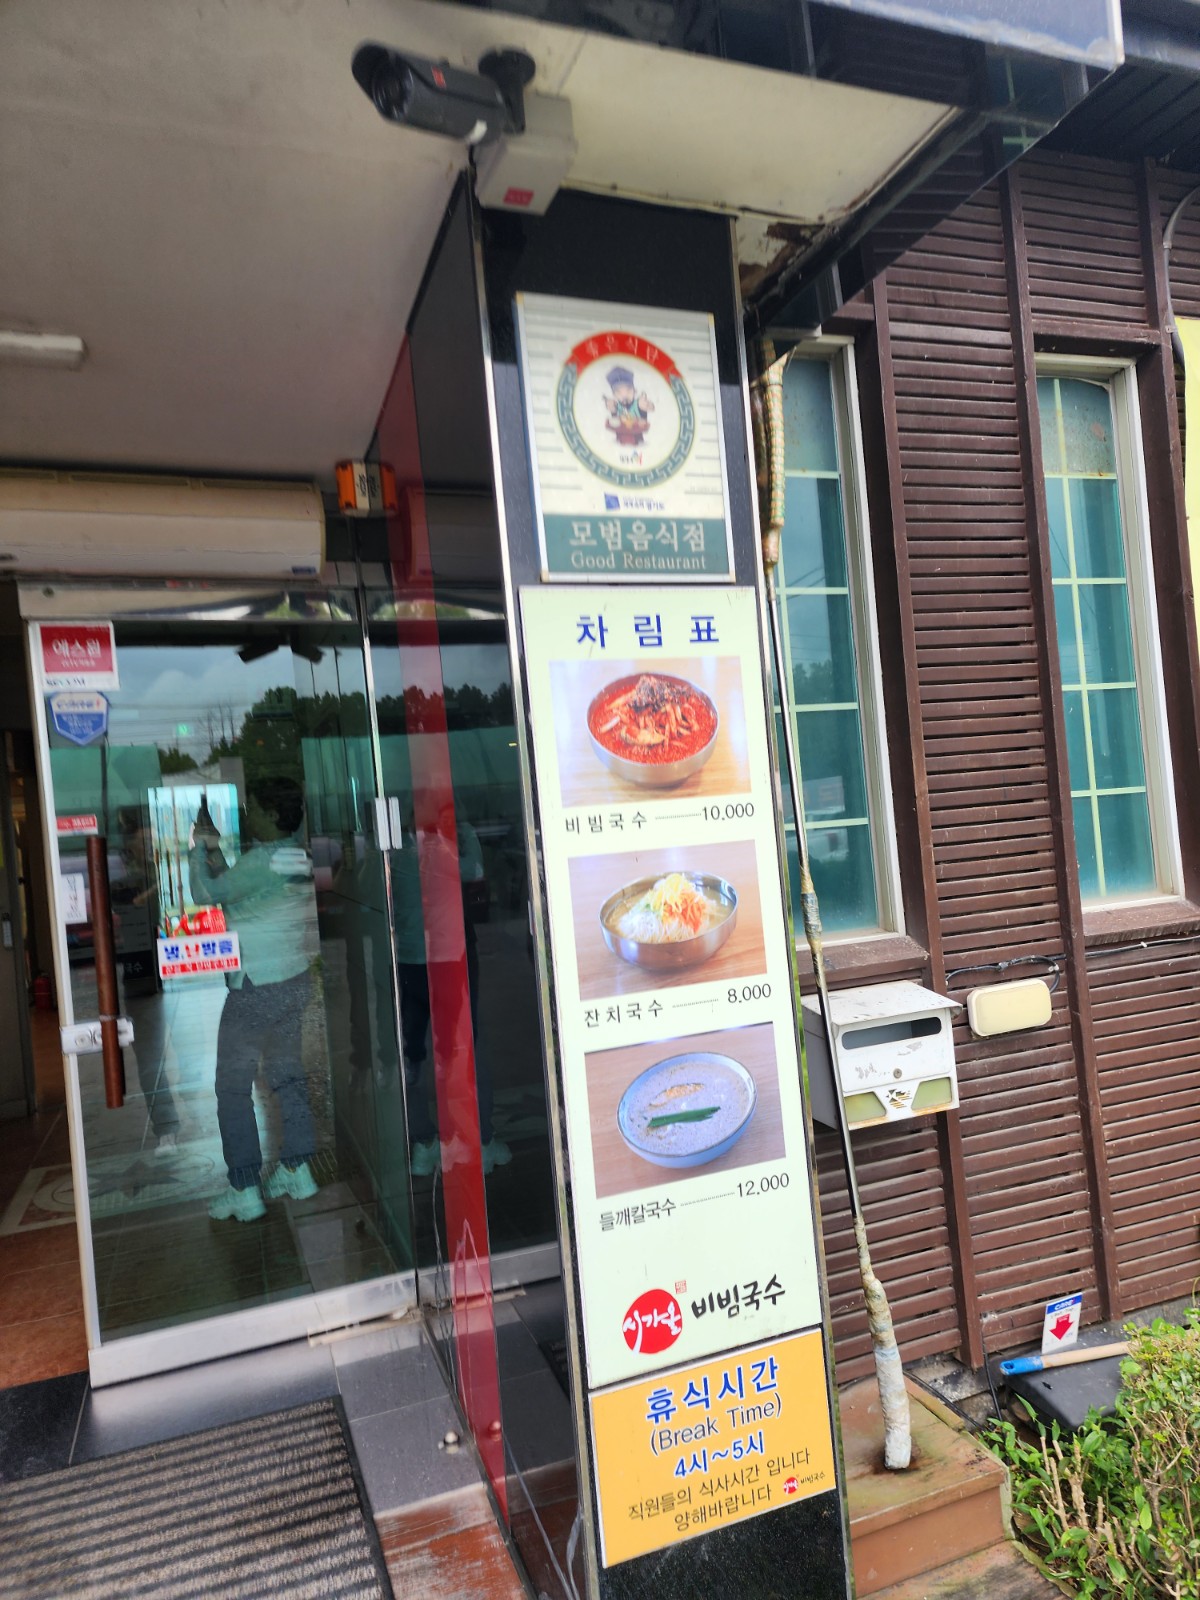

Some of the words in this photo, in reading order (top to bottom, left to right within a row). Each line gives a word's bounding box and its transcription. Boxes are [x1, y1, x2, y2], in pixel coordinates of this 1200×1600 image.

[569, 518, 705, 552] 모범음식점
[571, 551, 616, 569] Good
[623, 552, 706, 570] Restaurant
[52, 638, 101, 659] 에스원
[564, 811, 648, 835] 비빔국수
[583, 999, 664, 1028] 잔치국수
[599, 1198, 677, 1232] 들깨칼국수
[691, 1273, 786, 1319] 비빔국수
[646, 1356, 779, 1424] 휴식시간
[650, 1416, 720, 1456] (Break
[726, 1392, 782, 1429] Time)
[674, 1431, 765, 1478] 4시~5시
[628, 1486, 692, 1521] 직원들의
[699, 1464, 761, 1498] 식사시간
[766, 1447, 811, 1477] 입니다
[674, 1483, 773, 1532] 양해바랍니다
